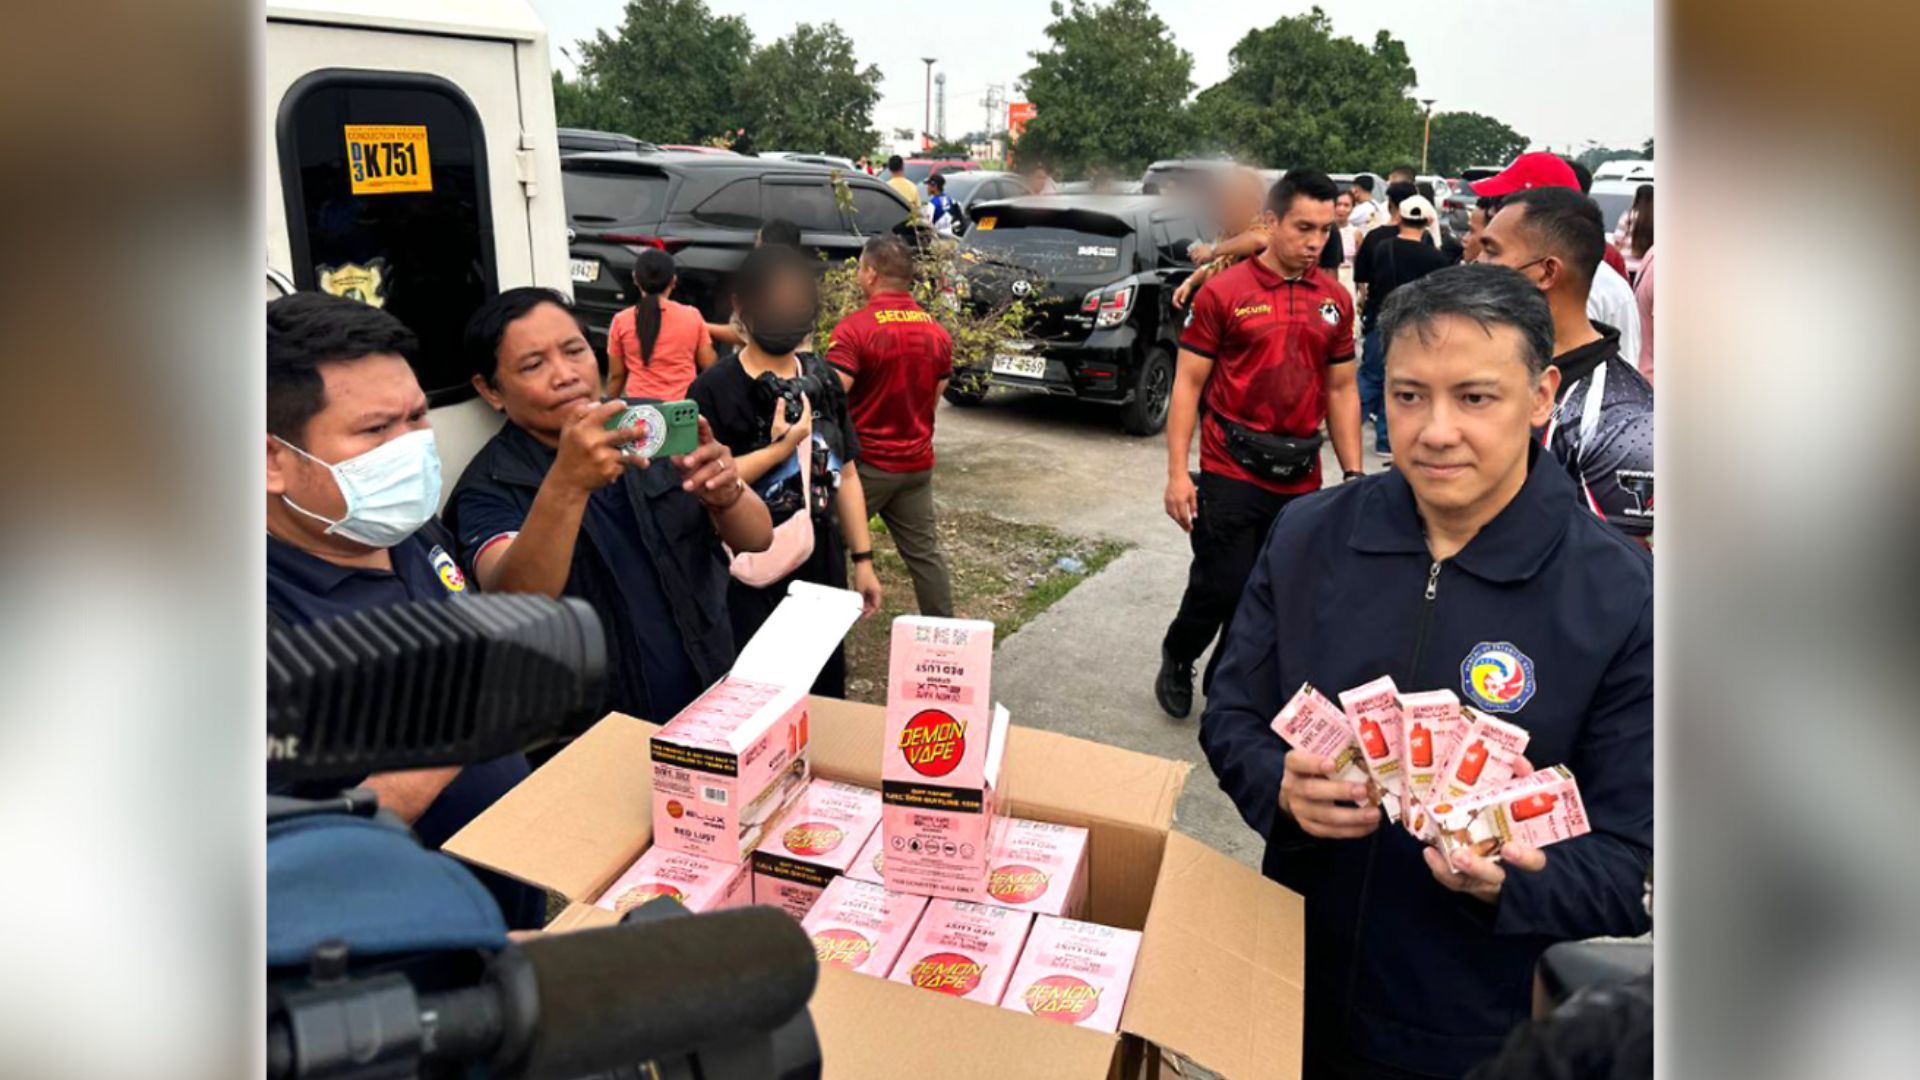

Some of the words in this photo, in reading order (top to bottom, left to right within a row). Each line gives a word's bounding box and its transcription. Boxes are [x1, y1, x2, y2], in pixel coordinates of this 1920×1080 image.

[897, 719, 968, 749] DEMON
[910, 741, 957, 764] VAPE
[1023, 984, 1105, 999] DEMON
[1033, 998, 1085, 1014] VAPE
